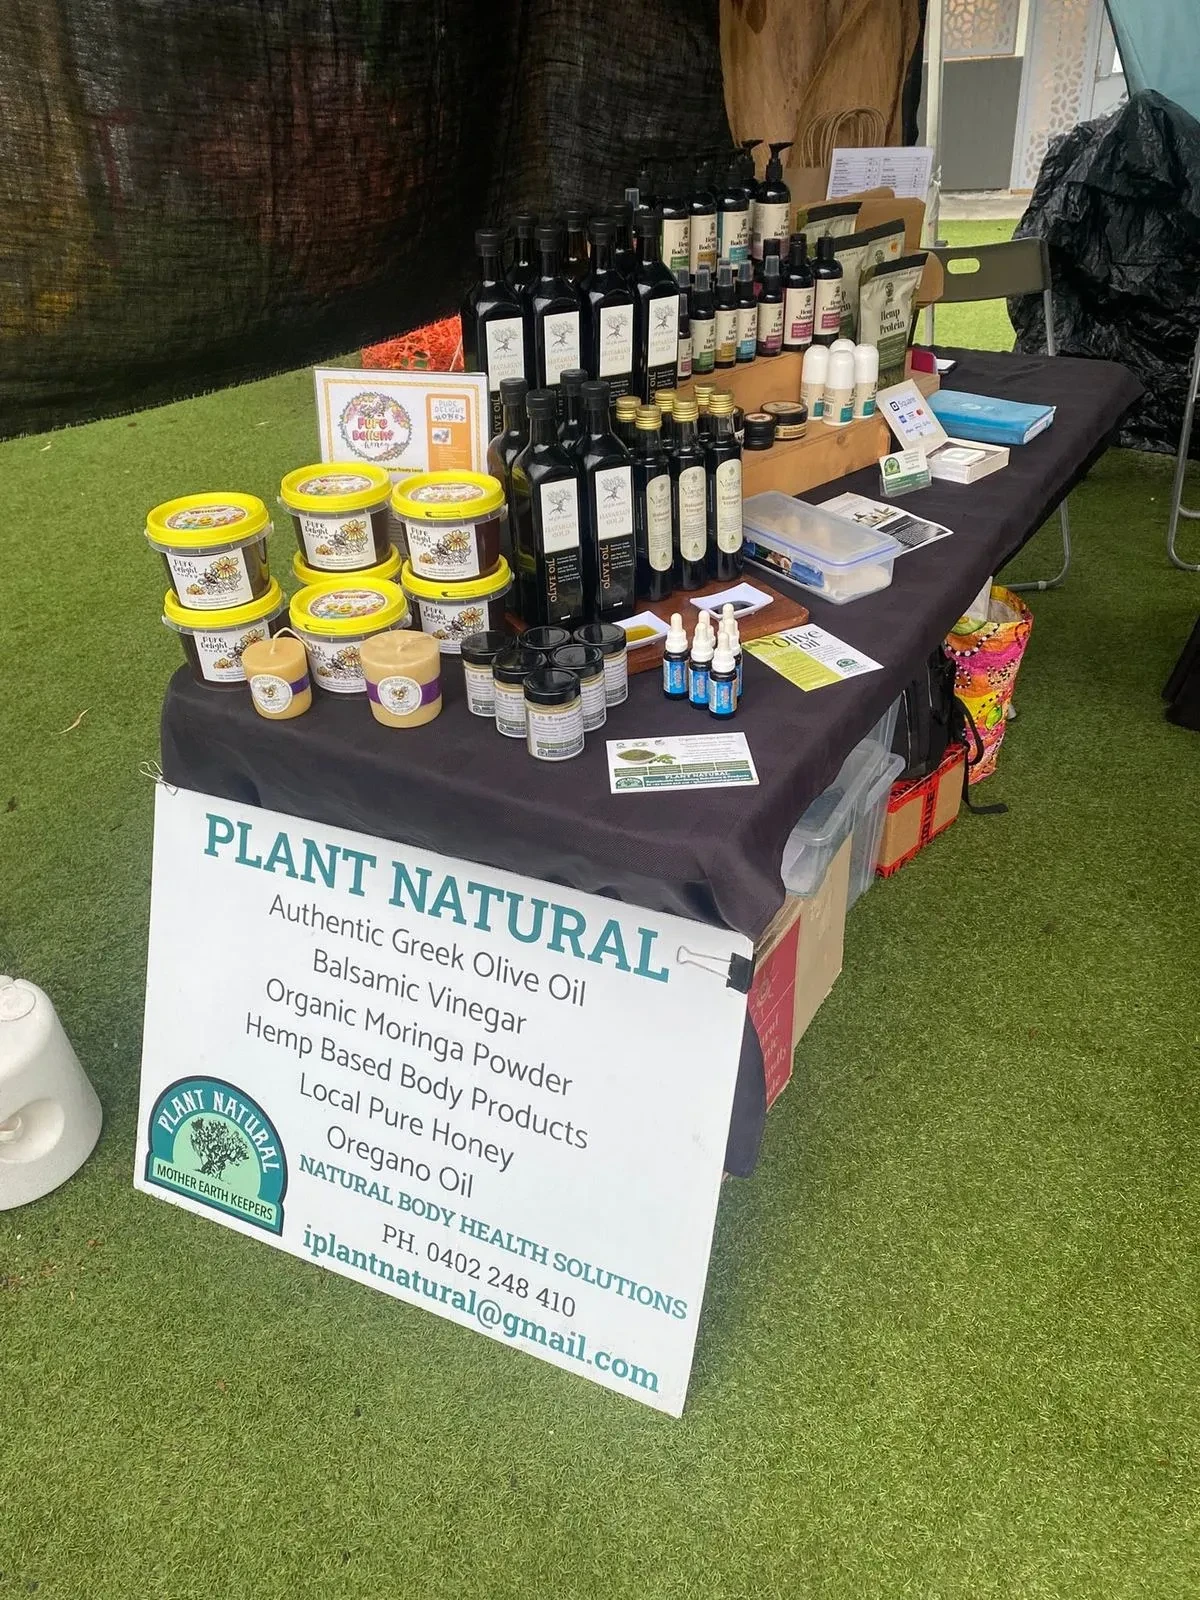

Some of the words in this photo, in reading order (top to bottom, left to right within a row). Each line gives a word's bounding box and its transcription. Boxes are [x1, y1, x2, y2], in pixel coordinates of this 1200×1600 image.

[880, 320, 905, 334] Protein
[881, 308, 900, 320] Hemp
[352, 430, 395, 442] Delight
[357, 418, 388, 431] Pure
[434, 406, 465, 414] DELIGHT
[545, 558, 555, 574] OIL
[600, 544, 609, 560] OIL
[601, 562, 611, 589] OLIVE
[548, 576, 557, 603] OLIVE
[772, 631, 819, 648] Olive
[203, 812, 378, 898] PLANT
[388, 860, 670, 984] NATURAL
[268, 893, 385, 947] Authentic
[391, 927, 465, 972] Greek
[472, 951, 540, 993] Olive
[548, 973, 587, 1008] Oil
[313, 947, 420, 1003] Balsamic
[427, 981, 528, 1035] Vinegar
[266, 977, 357, 1027] Organic
[364, 1007, 464, 1063] Moringa
[472, 1041, 574, 1097] Powder
[245, 1011, 313, 1060] Hemp
[320, 1036, 393, 1083] Based
[400, 1062, 464, 1111] Body
[471, 1086, 589, 1150] Products
[157, 1089, 205, 1134] PLANT
[213, 1090, 280, 1173] NATURAL
[299, 1071, 361, 1115] Local
[368, 1095, 424, 1137] Pure
[431, 1117, 515, 1174] Honey
[157, 1163, 197, 1190] MOTHER
[198, 1180, 229, 1203] EARTH
[231, 1193, 273, 1221] KEEPERS
[326, 1125, 431, 1182] Oregano
[438, 1166, 474, 1199] Oil
[298, 1153, 394, 1207] NATURAL
[396, 1191, 457, 1229] BODY
[458, 1214, 550, 1267] HEALTH
[552, 1252, 689, 1321] SOLUTIONS
[381, 1222, 419, 1256] PH.
[426, 1241, 481, 1281] 0402
[486, 1265, 530, 1299] 248
[535, 1287, 576, 1318] 410
[302, 1223, 660, 1393] iplantnatural@gmail.com
